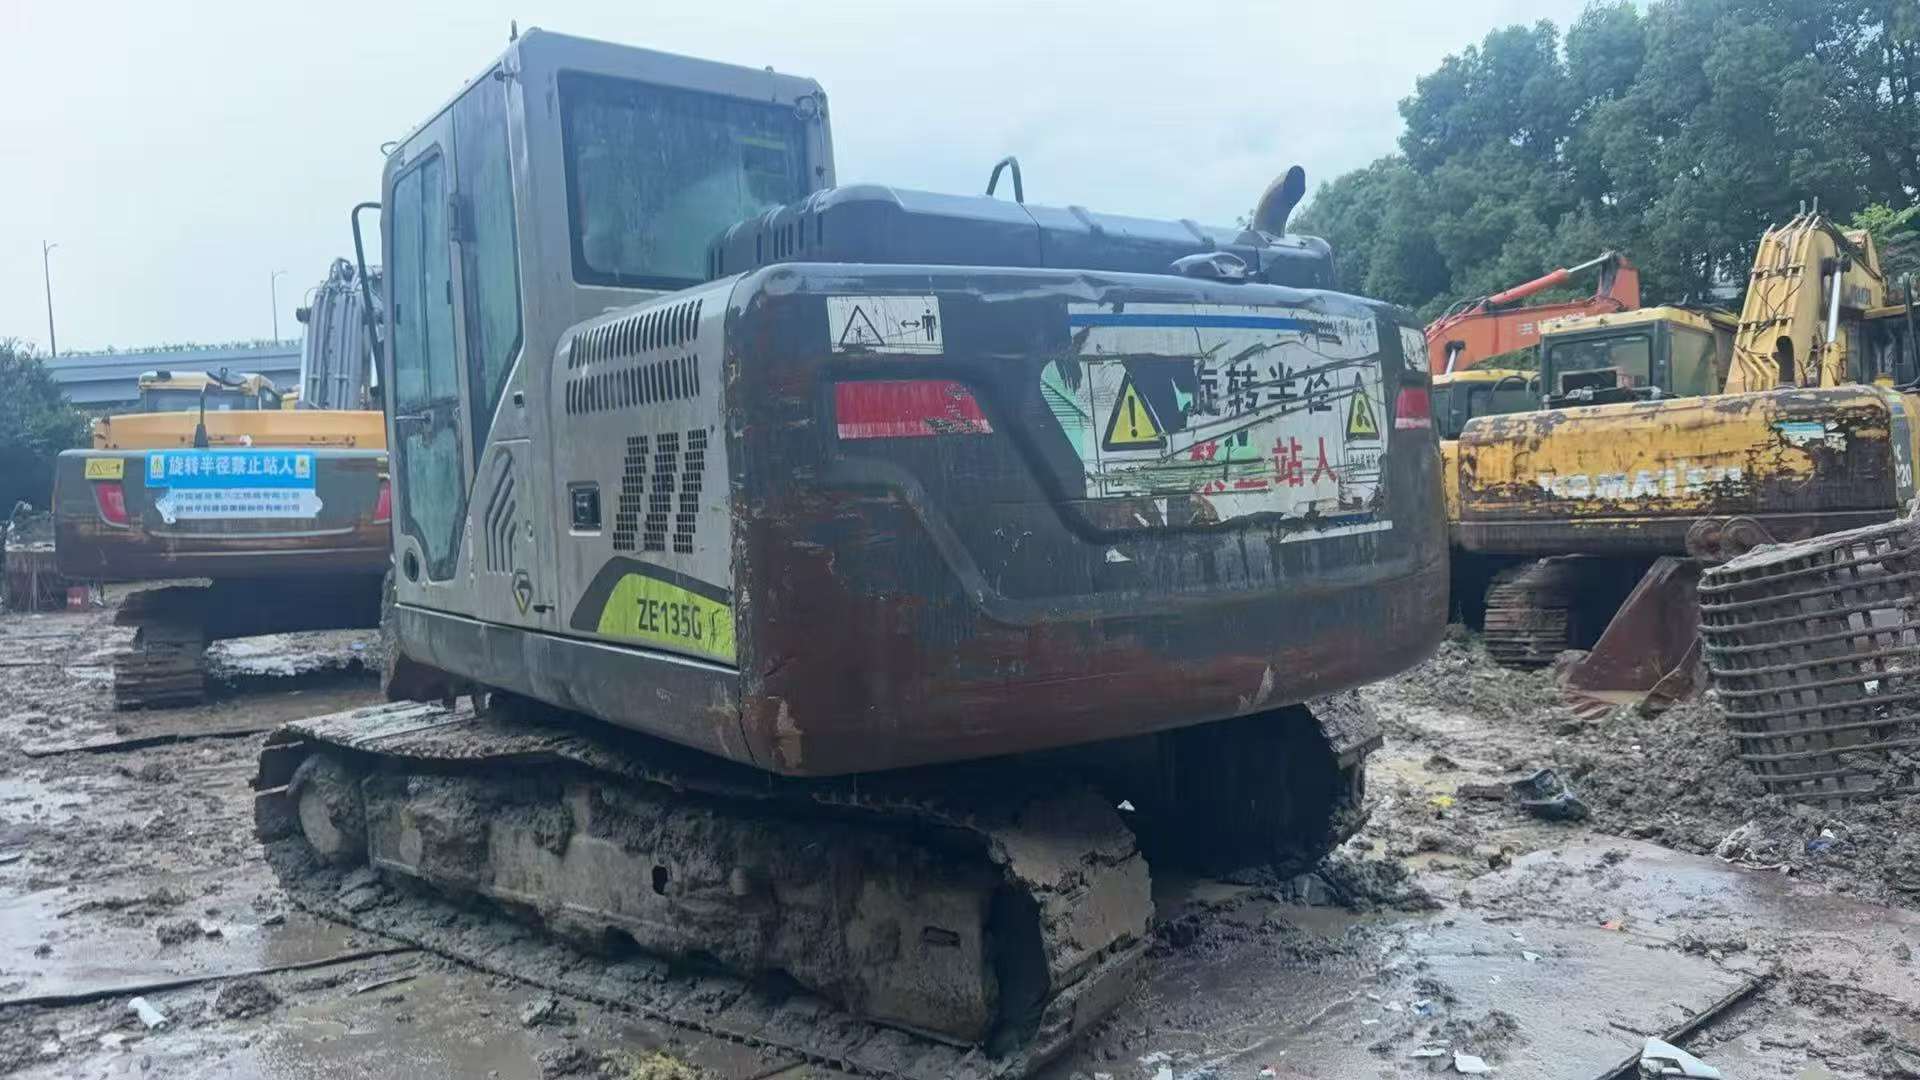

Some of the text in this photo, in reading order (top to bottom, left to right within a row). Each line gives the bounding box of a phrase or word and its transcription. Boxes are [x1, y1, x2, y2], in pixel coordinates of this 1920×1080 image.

[168, 455, 294, 476] 旋转半径禁止站人
